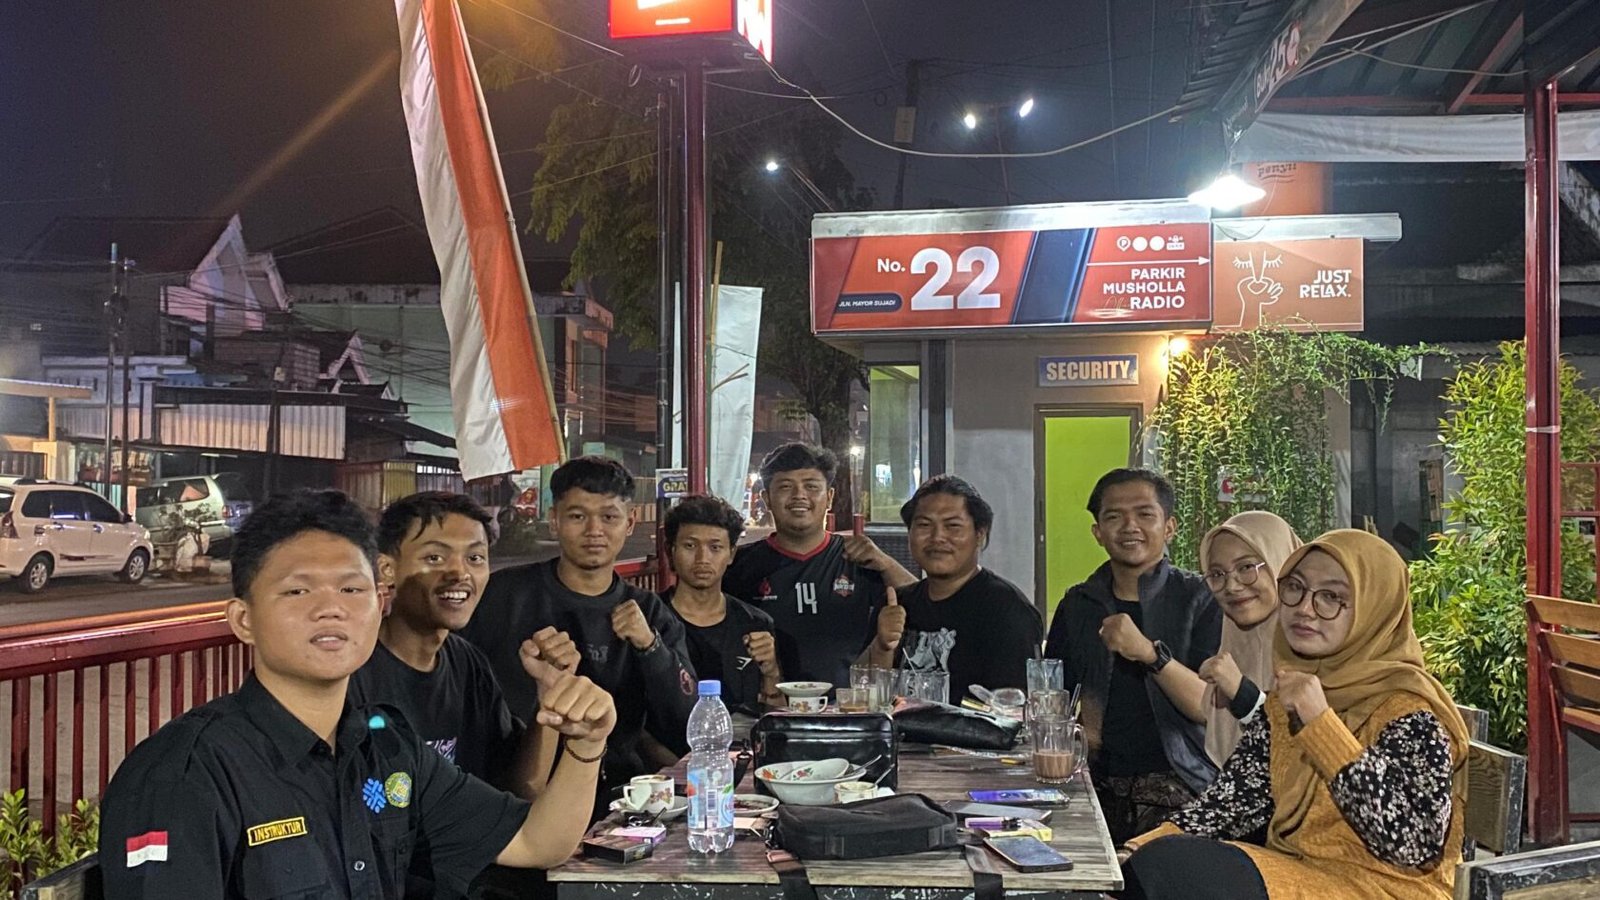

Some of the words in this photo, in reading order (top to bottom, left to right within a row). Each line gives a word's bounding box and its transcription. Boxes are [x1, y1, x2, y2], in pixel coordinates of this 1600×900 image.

[877, 258, 906, 273] No.
[910, 245, 1001, 311] 22
[1131, 267, 1186, 280] PARKIR
[1313, 269, 1352, 284] JUST
[1103, 281, 1186, 294] MUSHOLLA
[1299, 284, 1352, 298] RELAX.
[874, 299, 897, 307] SUJADI
[1130, 295, 1186, 309] RADIO
[1046, 360, 1131, 380] SECURITY
[795, 582, 818, 614] 14
[253, 821, 302, 842] INSTRUKTUR
